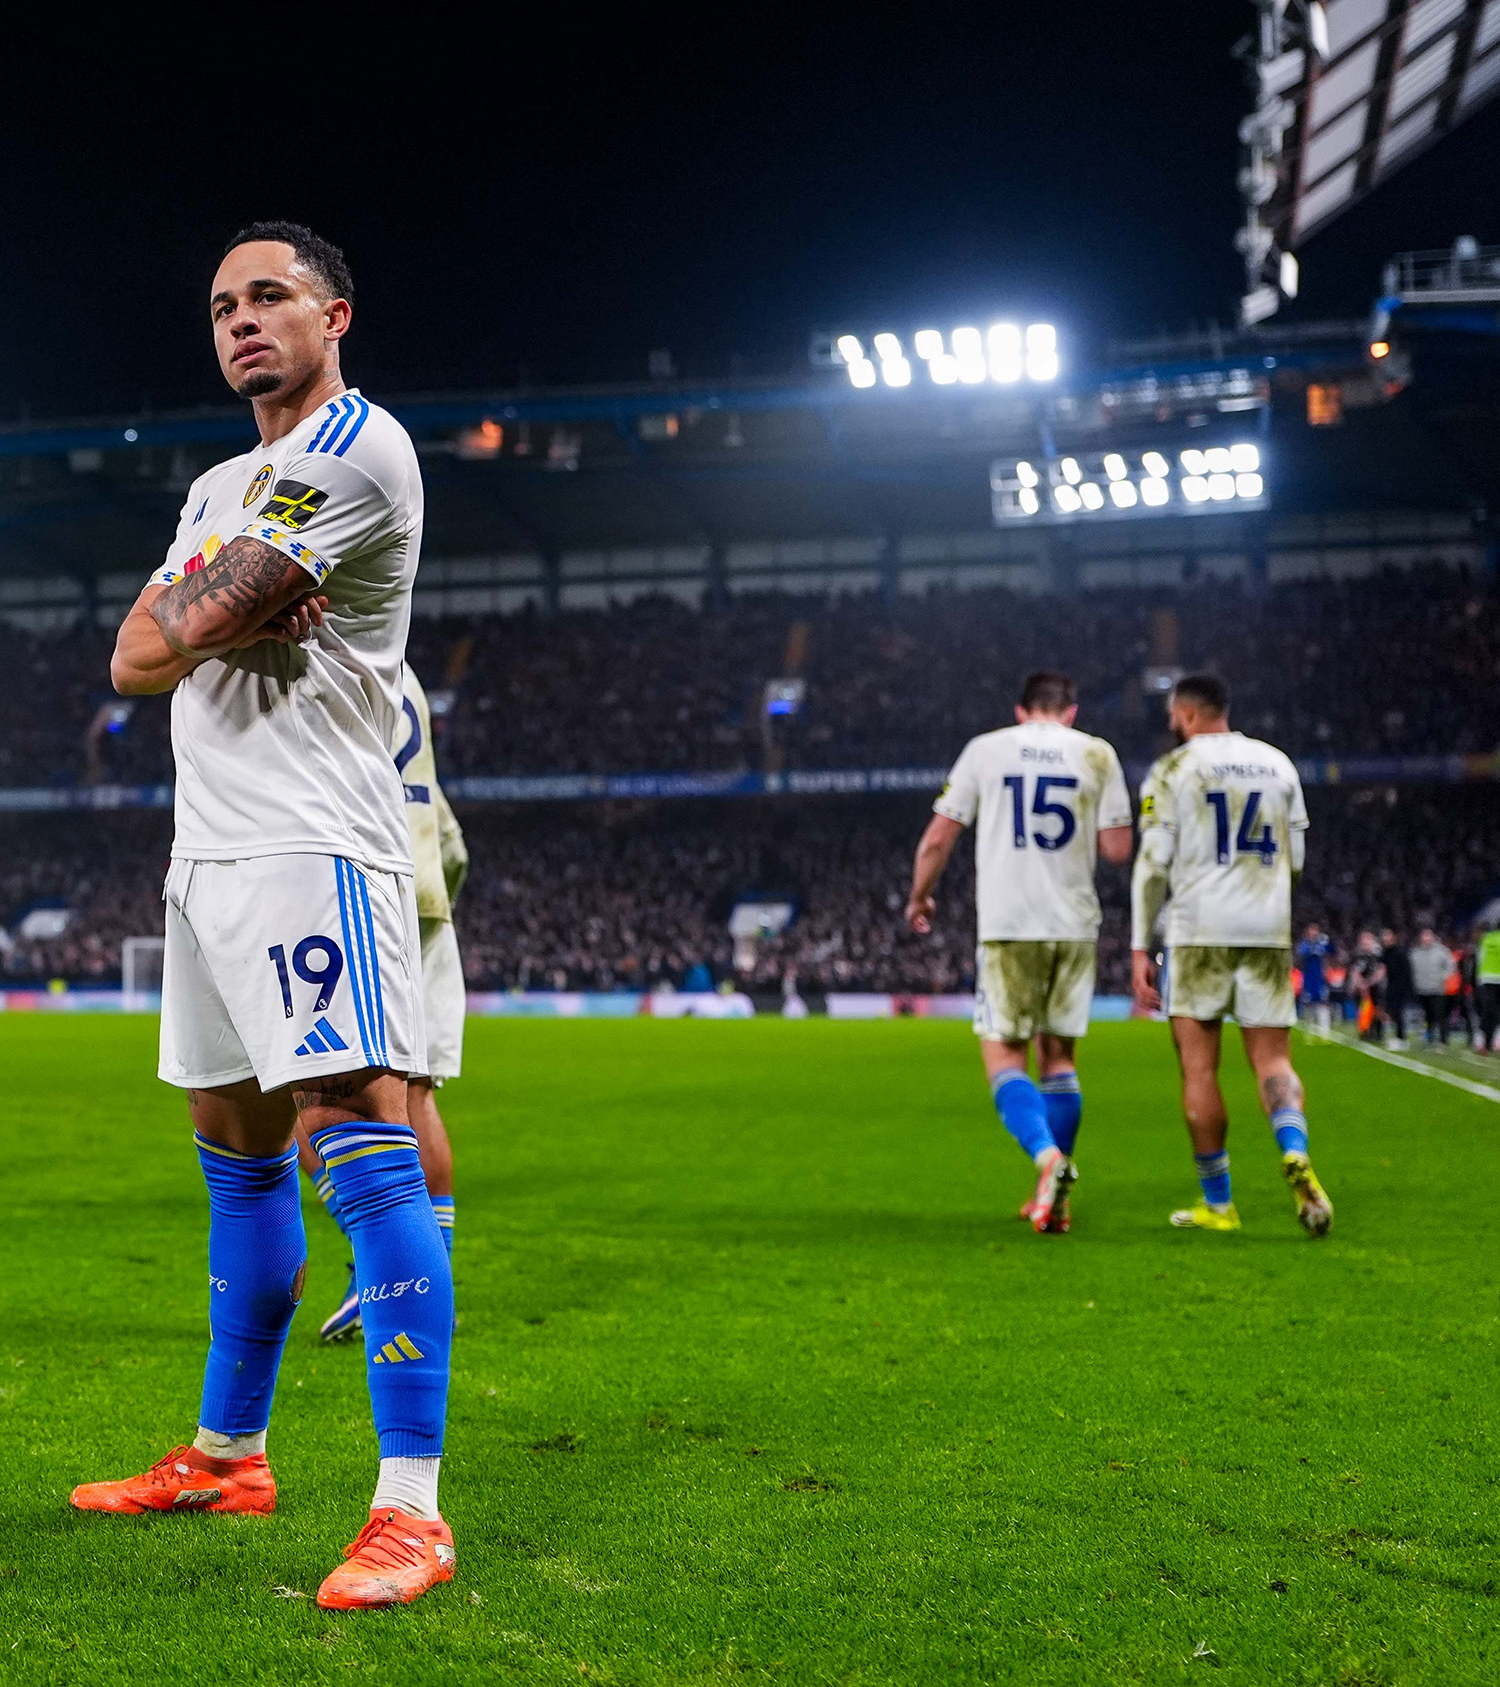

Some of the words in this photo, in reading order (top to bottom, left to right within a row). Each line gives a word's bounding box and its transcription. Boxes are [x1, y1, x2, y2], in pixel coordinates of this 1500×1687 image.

[1003, 775, 1079, 851] 15
[1205, 791, 1278, 867] 14
[267, 934, 344, 1019] 19
[360, 1276, 431, 1305] LUFC
